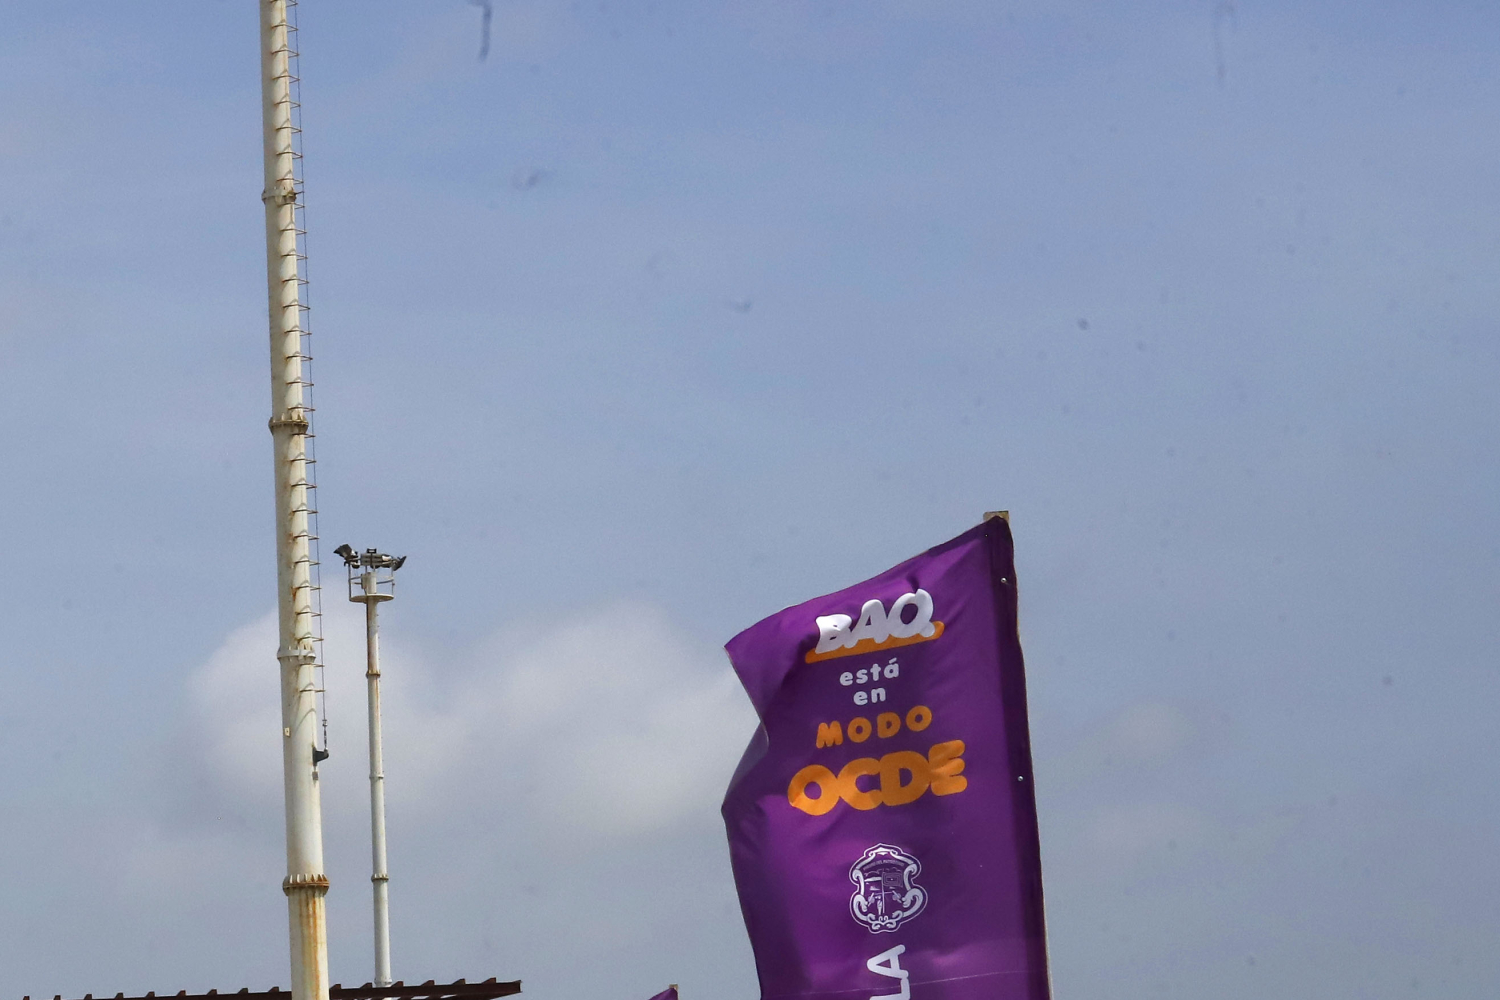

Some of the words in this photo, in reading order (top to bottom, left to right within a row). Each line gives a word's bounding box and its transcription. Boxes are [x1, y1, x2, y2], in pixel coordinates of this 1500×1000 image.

[814, 587, 936, 655] BAQ
[839, 657, 900, 687] está
[852, 686, 887, 706] en
[815, 705, 933, 749] MODO
[787, 739, 968, 816] OCDE
